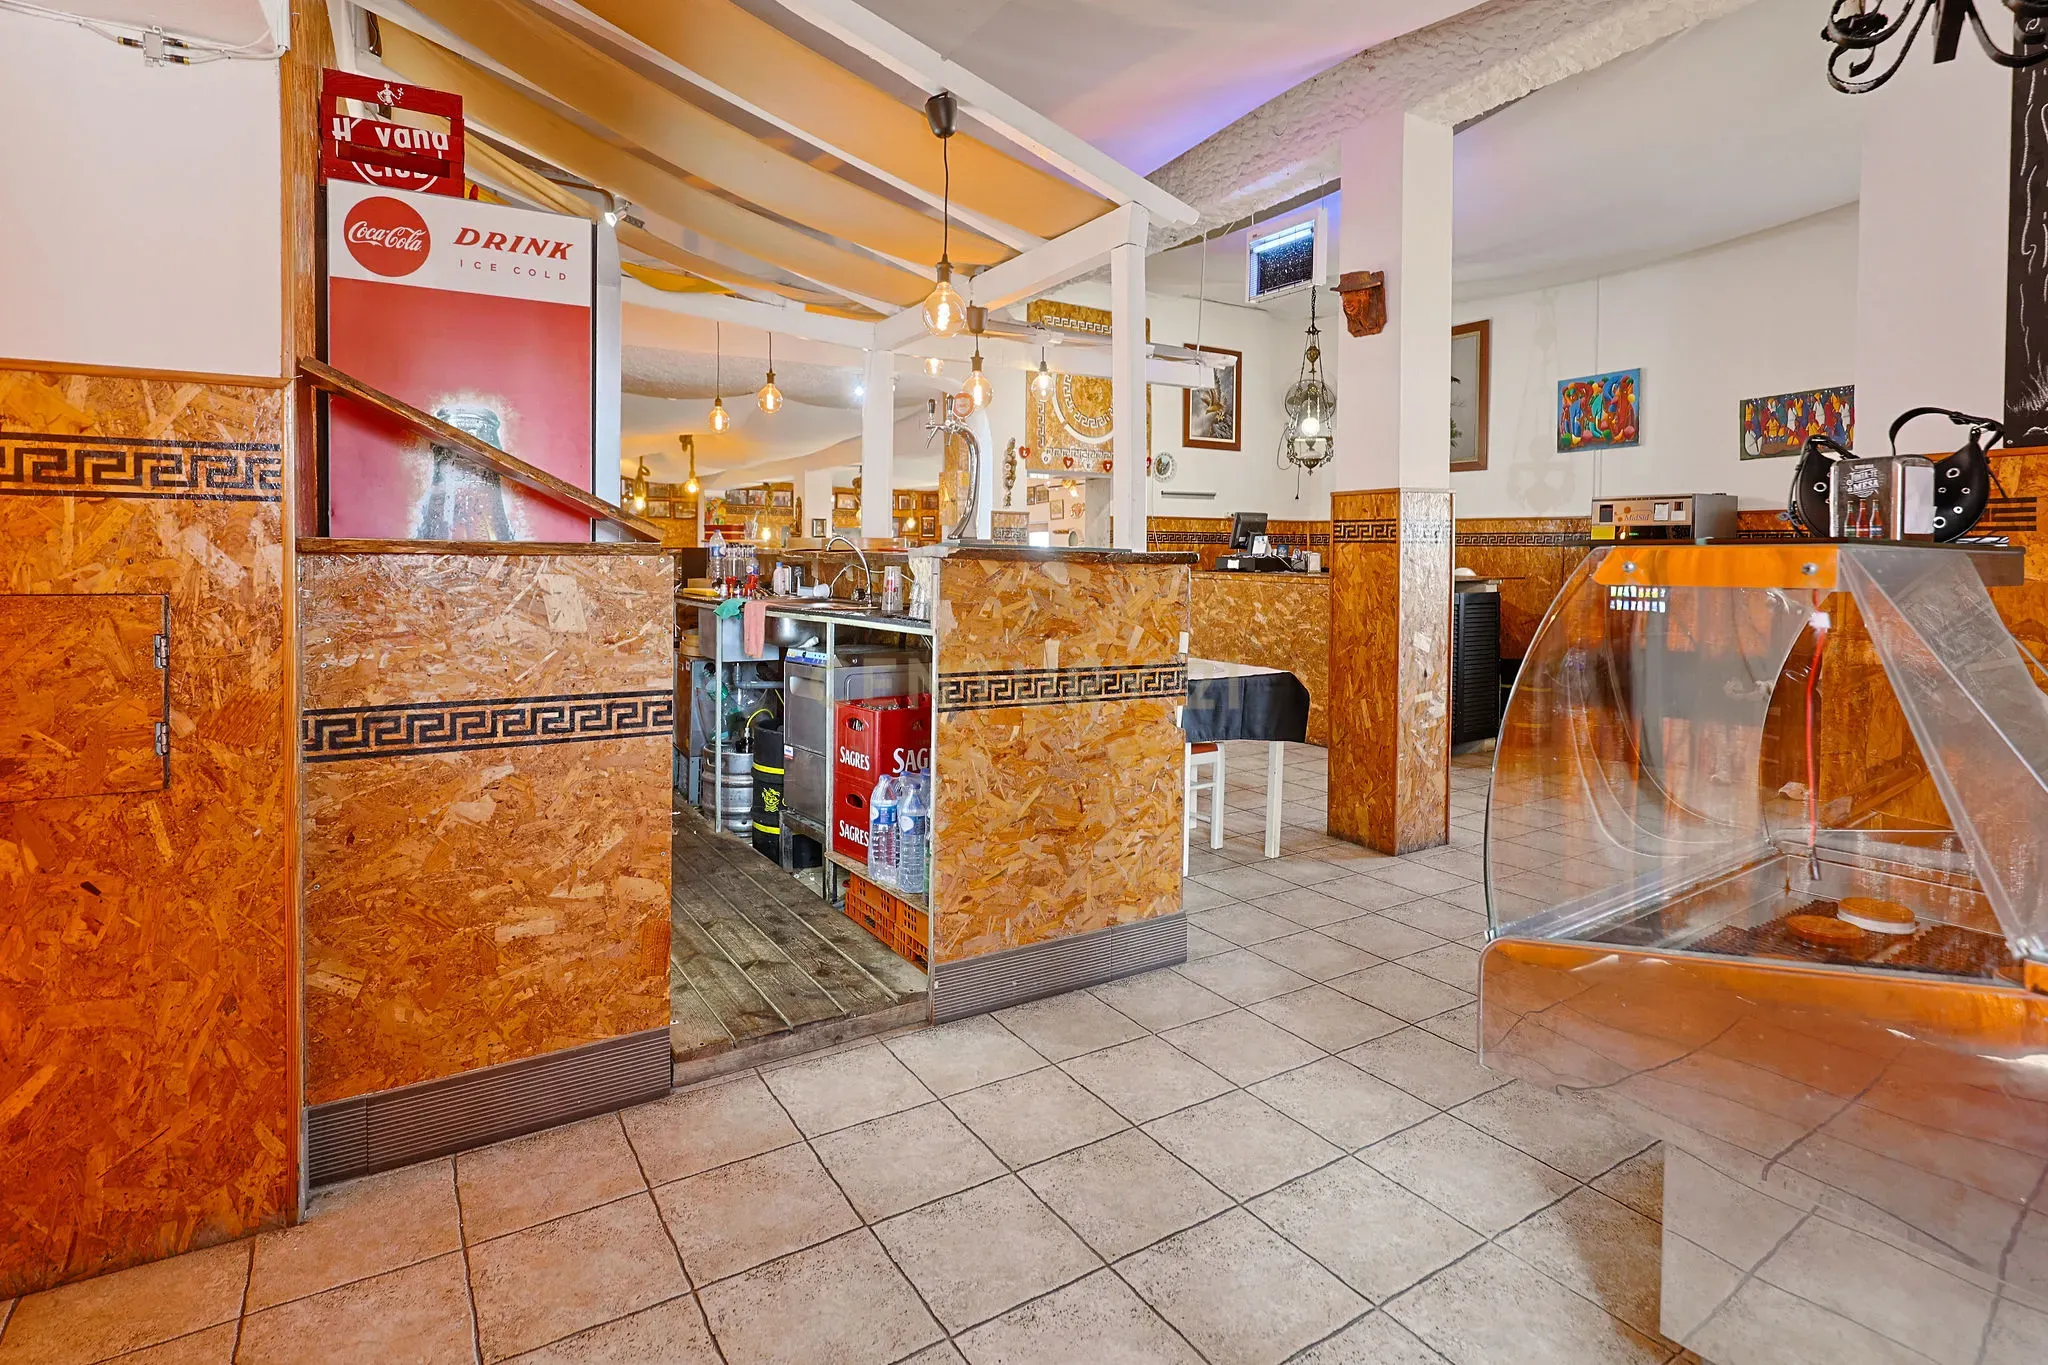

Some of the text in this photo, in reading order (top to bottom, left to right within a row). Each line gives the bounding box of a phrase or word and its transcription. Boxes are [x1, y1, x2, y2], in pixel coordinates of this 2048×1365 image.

[332, 117, 449, 151] Hvana
[348, 220, 427, 252] Coca-Cola
[452, 227, 574, 261] DRINK
[460, 259, 567, 281] ICE COLD
[839, 746, 870, 771] SAGRES
[892, 747, 931, 774] SAG
[839, 819, 869, 847] SAGRES
